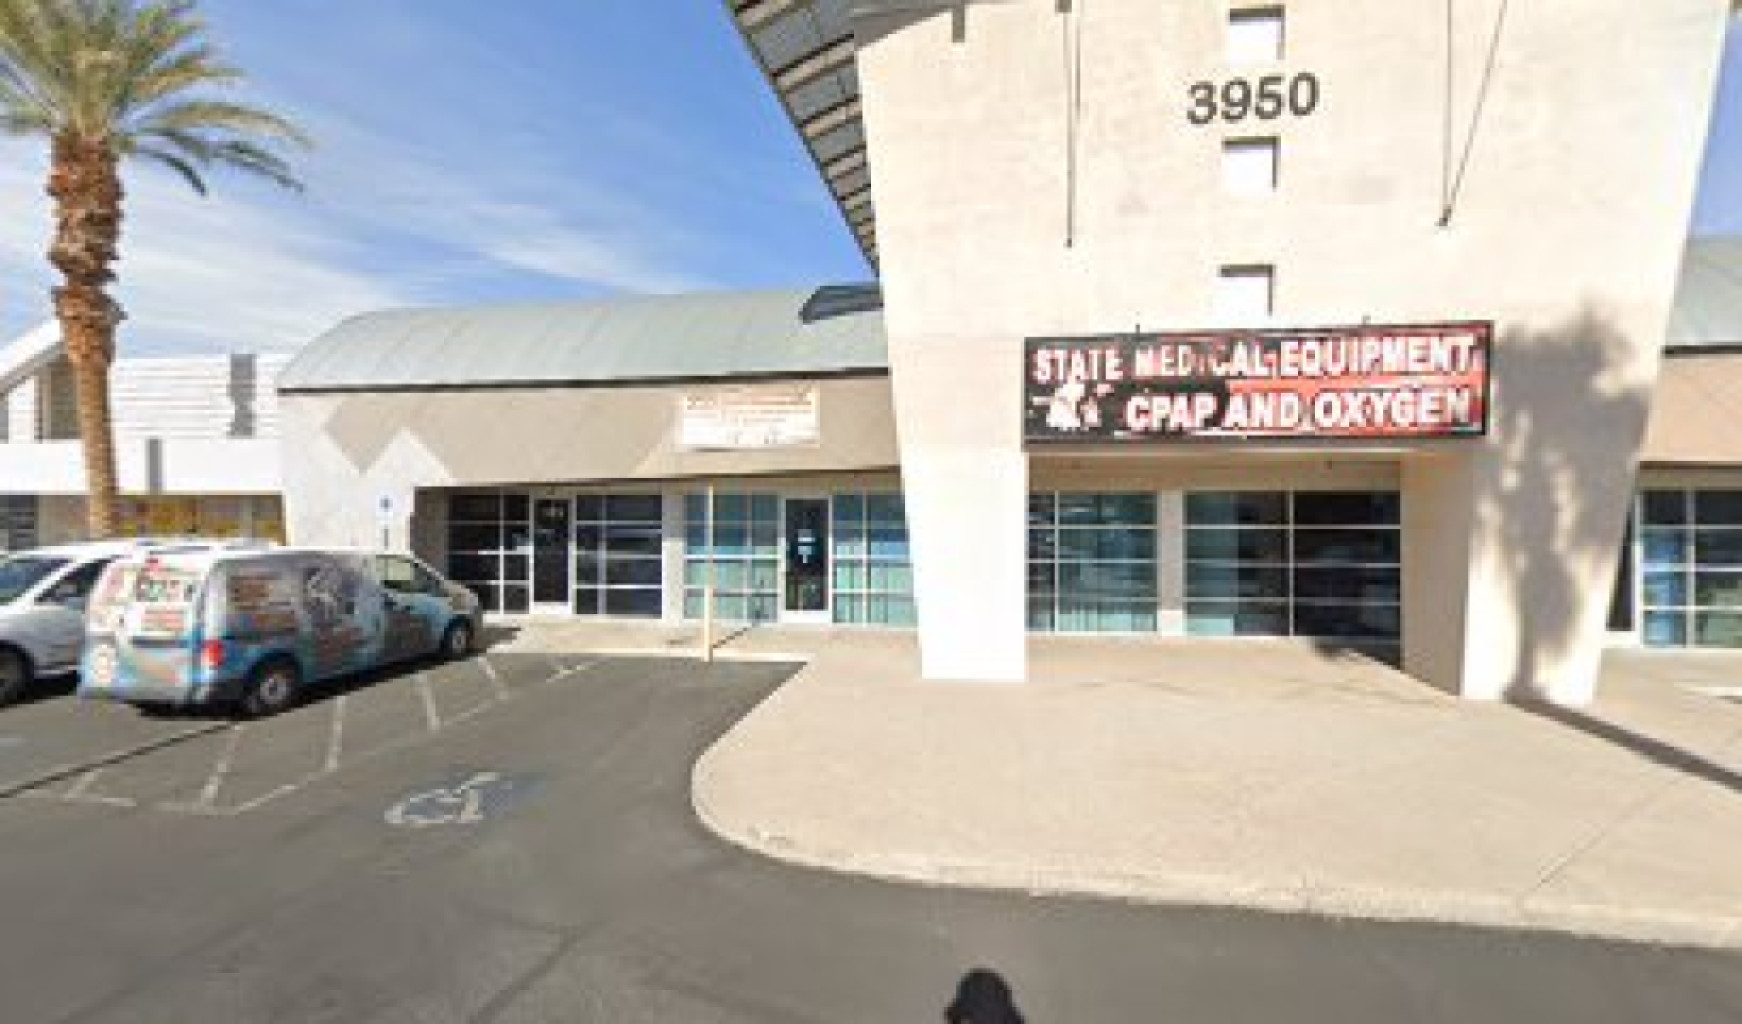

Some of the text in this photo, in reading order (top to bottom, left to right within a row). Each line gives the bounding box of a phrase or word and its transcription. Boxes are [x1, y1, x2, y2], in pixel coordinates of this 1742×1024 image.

[1187, 72, 1320, 125] 3950
[1034, 347, 1124, 384] STATE
[1280, 334, 1475, 378] EQUIPMENT
[1125, 387, 1471, 431] CPAP AND OXYGEN
